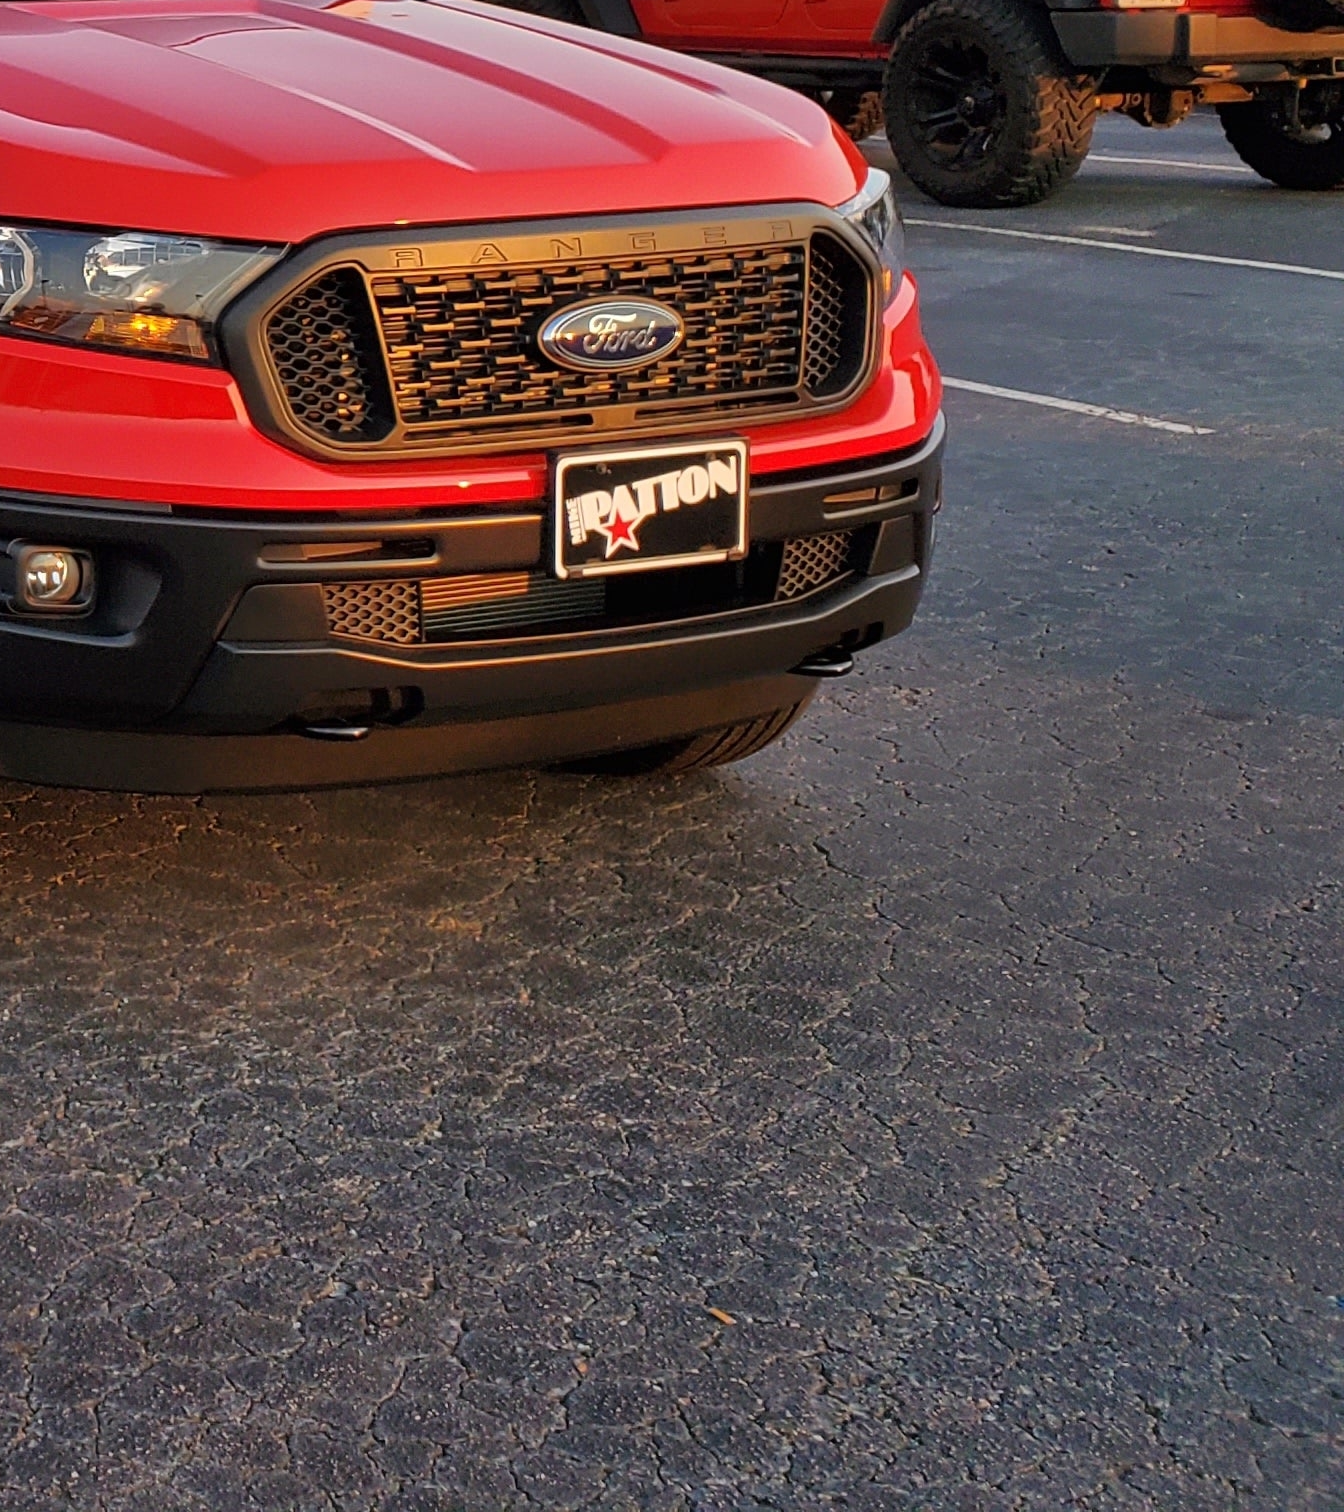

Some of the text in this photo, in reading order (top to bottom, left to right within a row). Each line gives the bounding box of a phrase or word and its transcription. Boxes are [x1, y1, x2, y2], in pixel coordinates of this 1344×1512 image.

[388, 219, 794, 269] RANGER
[583, 313, 657, 354] Ford
[580, 454, 738, 531] PATTON
